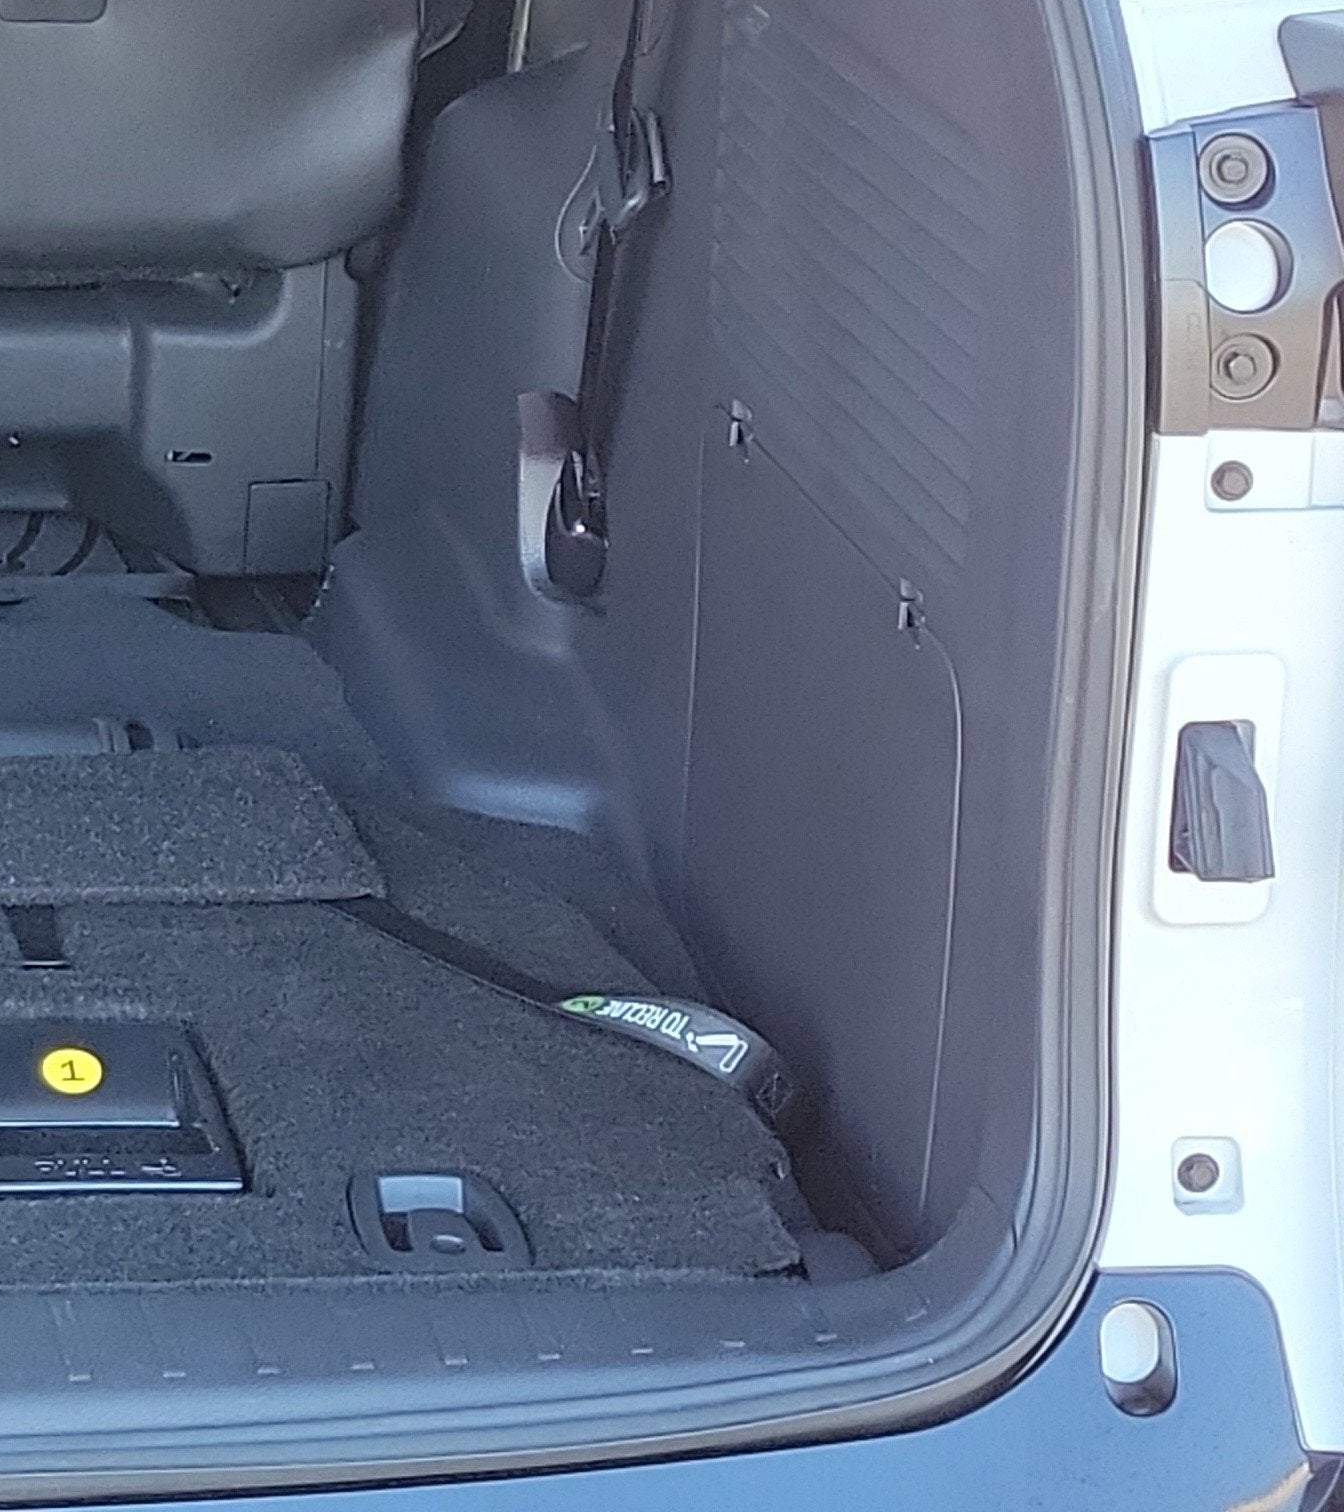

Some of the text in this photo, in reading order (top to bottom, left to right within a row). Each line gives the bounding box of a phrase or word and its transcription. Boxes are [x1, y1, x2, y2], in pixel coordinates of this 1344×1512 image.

[595, 999, 690, 1039] TO RECLINE
[60, 1059, 86, 1082] 1
